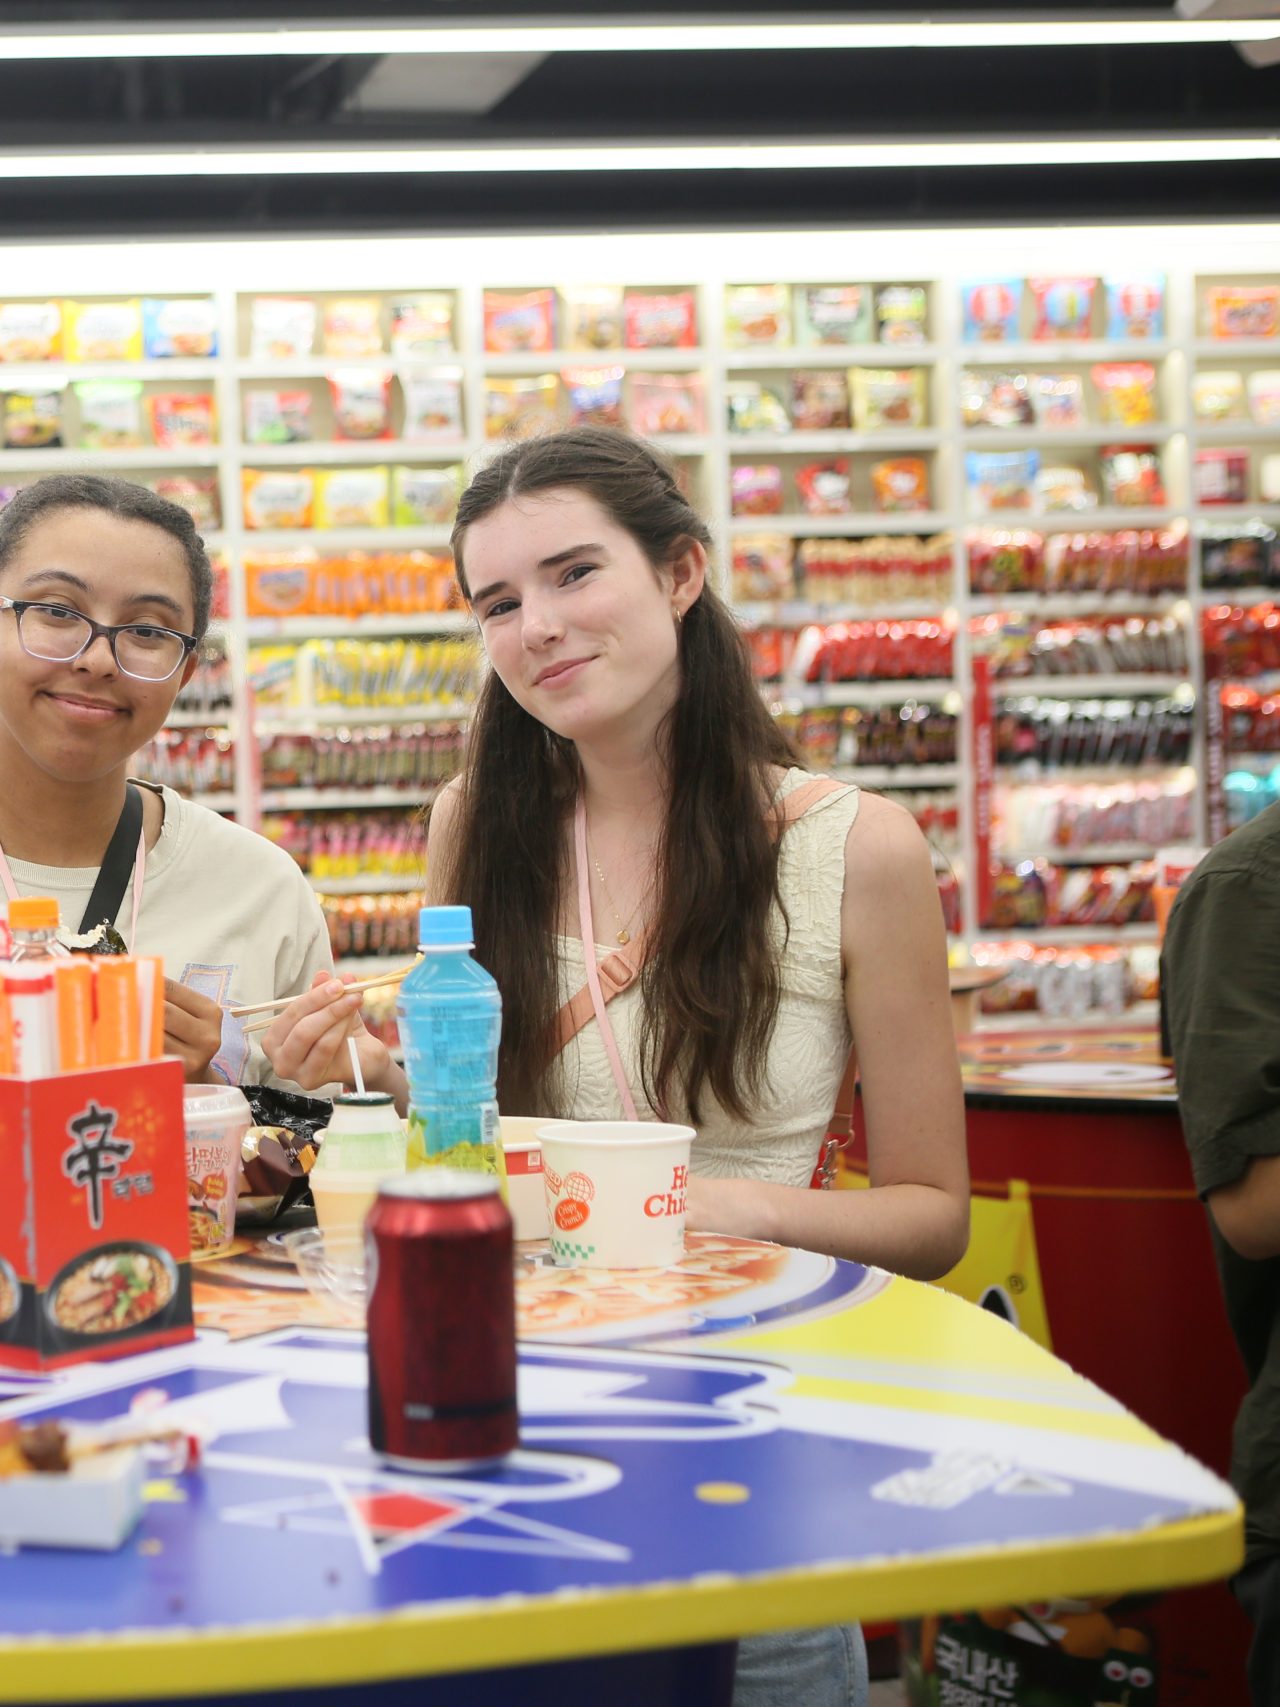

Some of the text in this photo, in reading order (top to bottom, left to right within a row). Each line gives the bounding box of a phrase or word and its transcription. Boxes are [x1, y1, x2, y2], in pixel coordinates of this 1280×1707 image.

[63, 1100, 133, 1228] 辛
[558, 1202, 577, 1217] Crispy
[560, 1210, 583, 1228] Crunch
[934, 1634, 1019, 1698] 국내산
